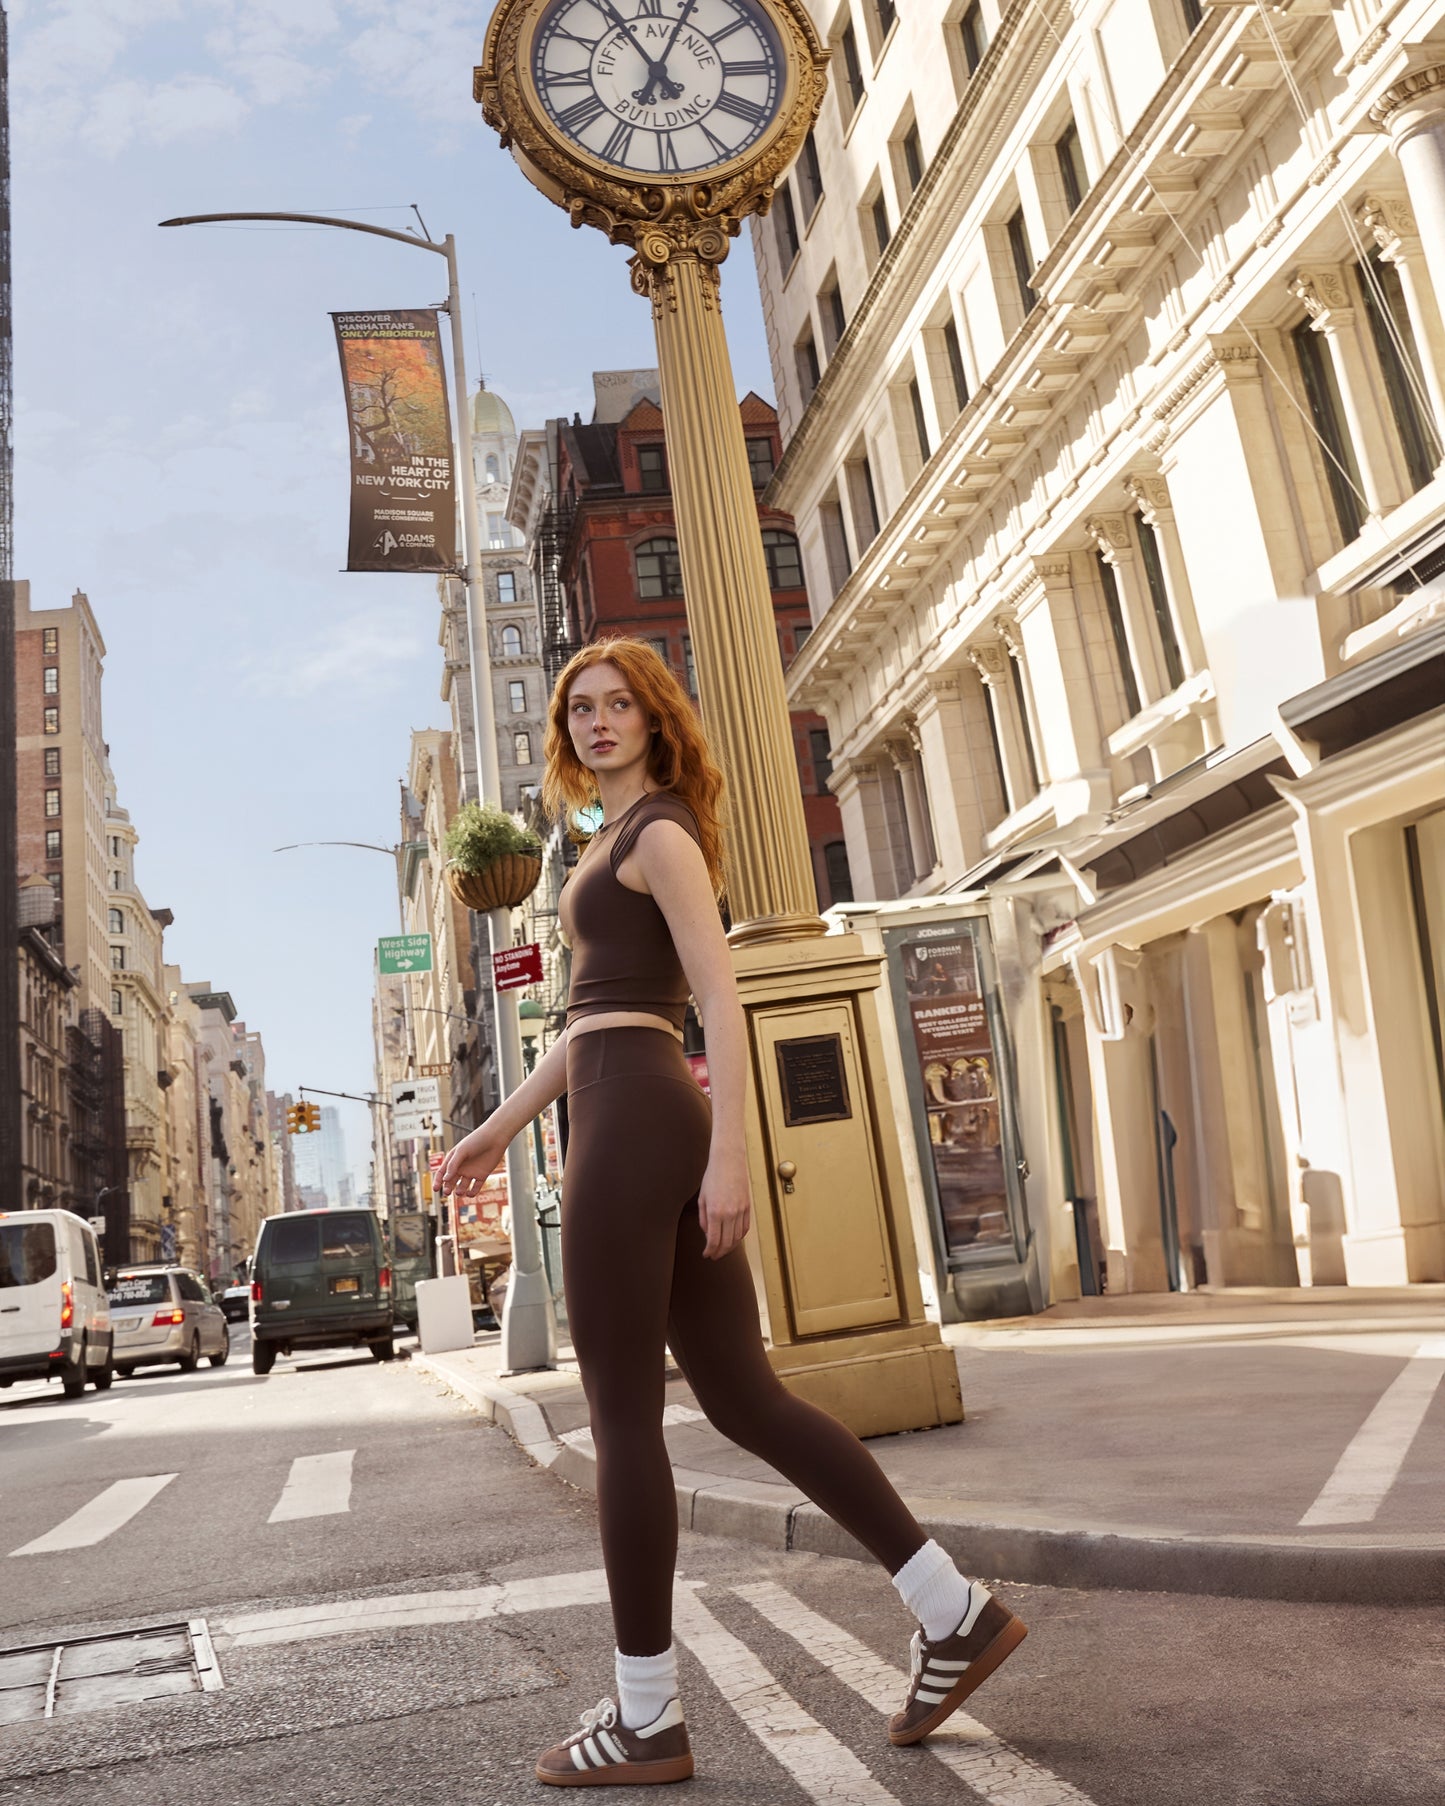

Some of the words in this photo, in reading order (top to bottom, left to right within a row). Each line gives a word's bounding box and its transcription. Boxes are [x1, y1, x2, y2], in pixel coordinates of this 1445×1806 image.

[614, 94, 712, 127] BUILDING
[337, 314, 391, 323] DISCOVER
[339, 322, 415, 331] MANHATTAN'S
[341, 330, 369, 338] ONLY
[371, 330, 436, 338] ARBORETUM
[411, 456, 423, 466] IN
[426, 457, 449, 468] THE
[391, 466, 430, 477] HEART
[433, 469, 450, 479] OF
[355, 475, 385, 486] NEW
[388, 477, 422, 488] YORK
[424, 479, 450, 490] CITY
[398, 534, 435, 543] ADAMS
[381, 939, 404, 949] West
[407, 937, 428, 947] Side
[384, 948, 426, 960] Highway
[495, 955, 504, 964] NO
[504, 948, 533, 961] STANDING
[914, 1005, 967, 1019] RANKED
[968, 1002, 984, 1012] #1
